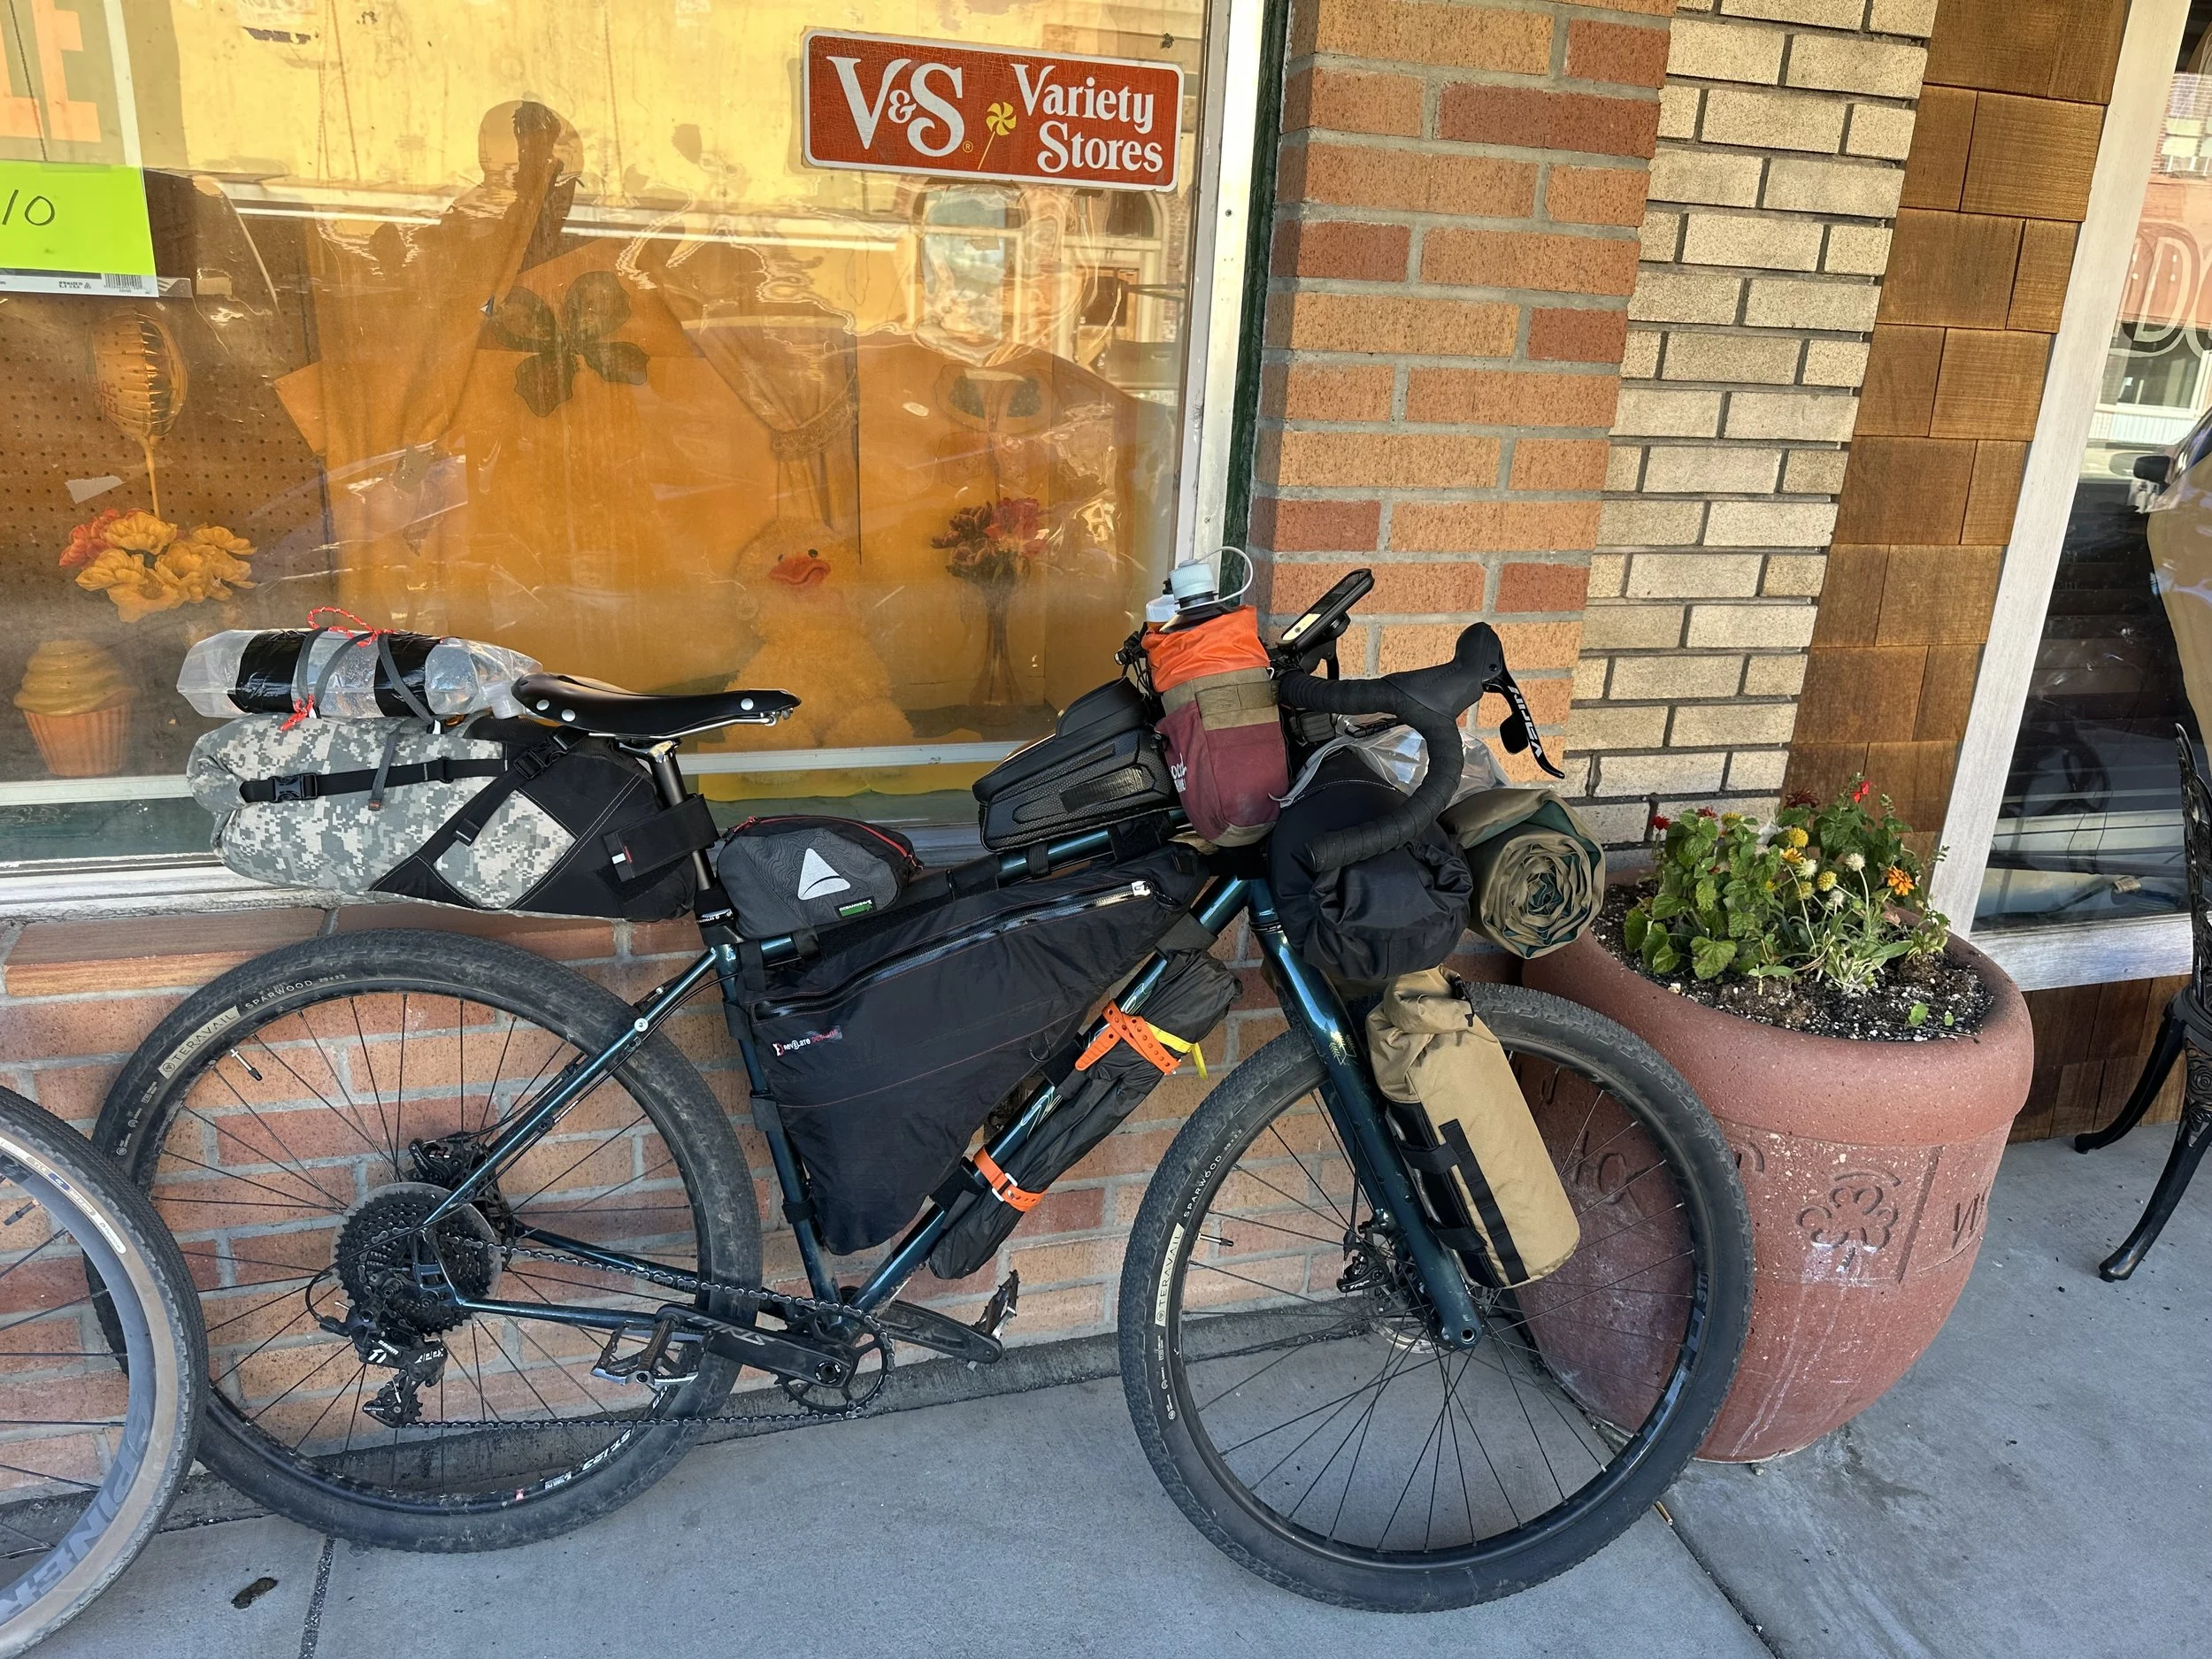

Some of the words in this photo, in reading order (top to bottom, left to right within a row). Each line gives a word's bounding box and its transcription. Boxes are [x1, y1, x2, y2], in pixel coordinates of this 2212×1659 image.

[1010, 64, 1154, 134] Variety
[1036, 120, 1164, 173] Stores
[245, 979, 313, 1009] SPARWOOD
[172, 1013, 237, 1062] TERAVAIL
[1183, 1154, 1223, 1218] SPARWOOD
[1158, 1231, 1182, 1306] TERAVAIL
